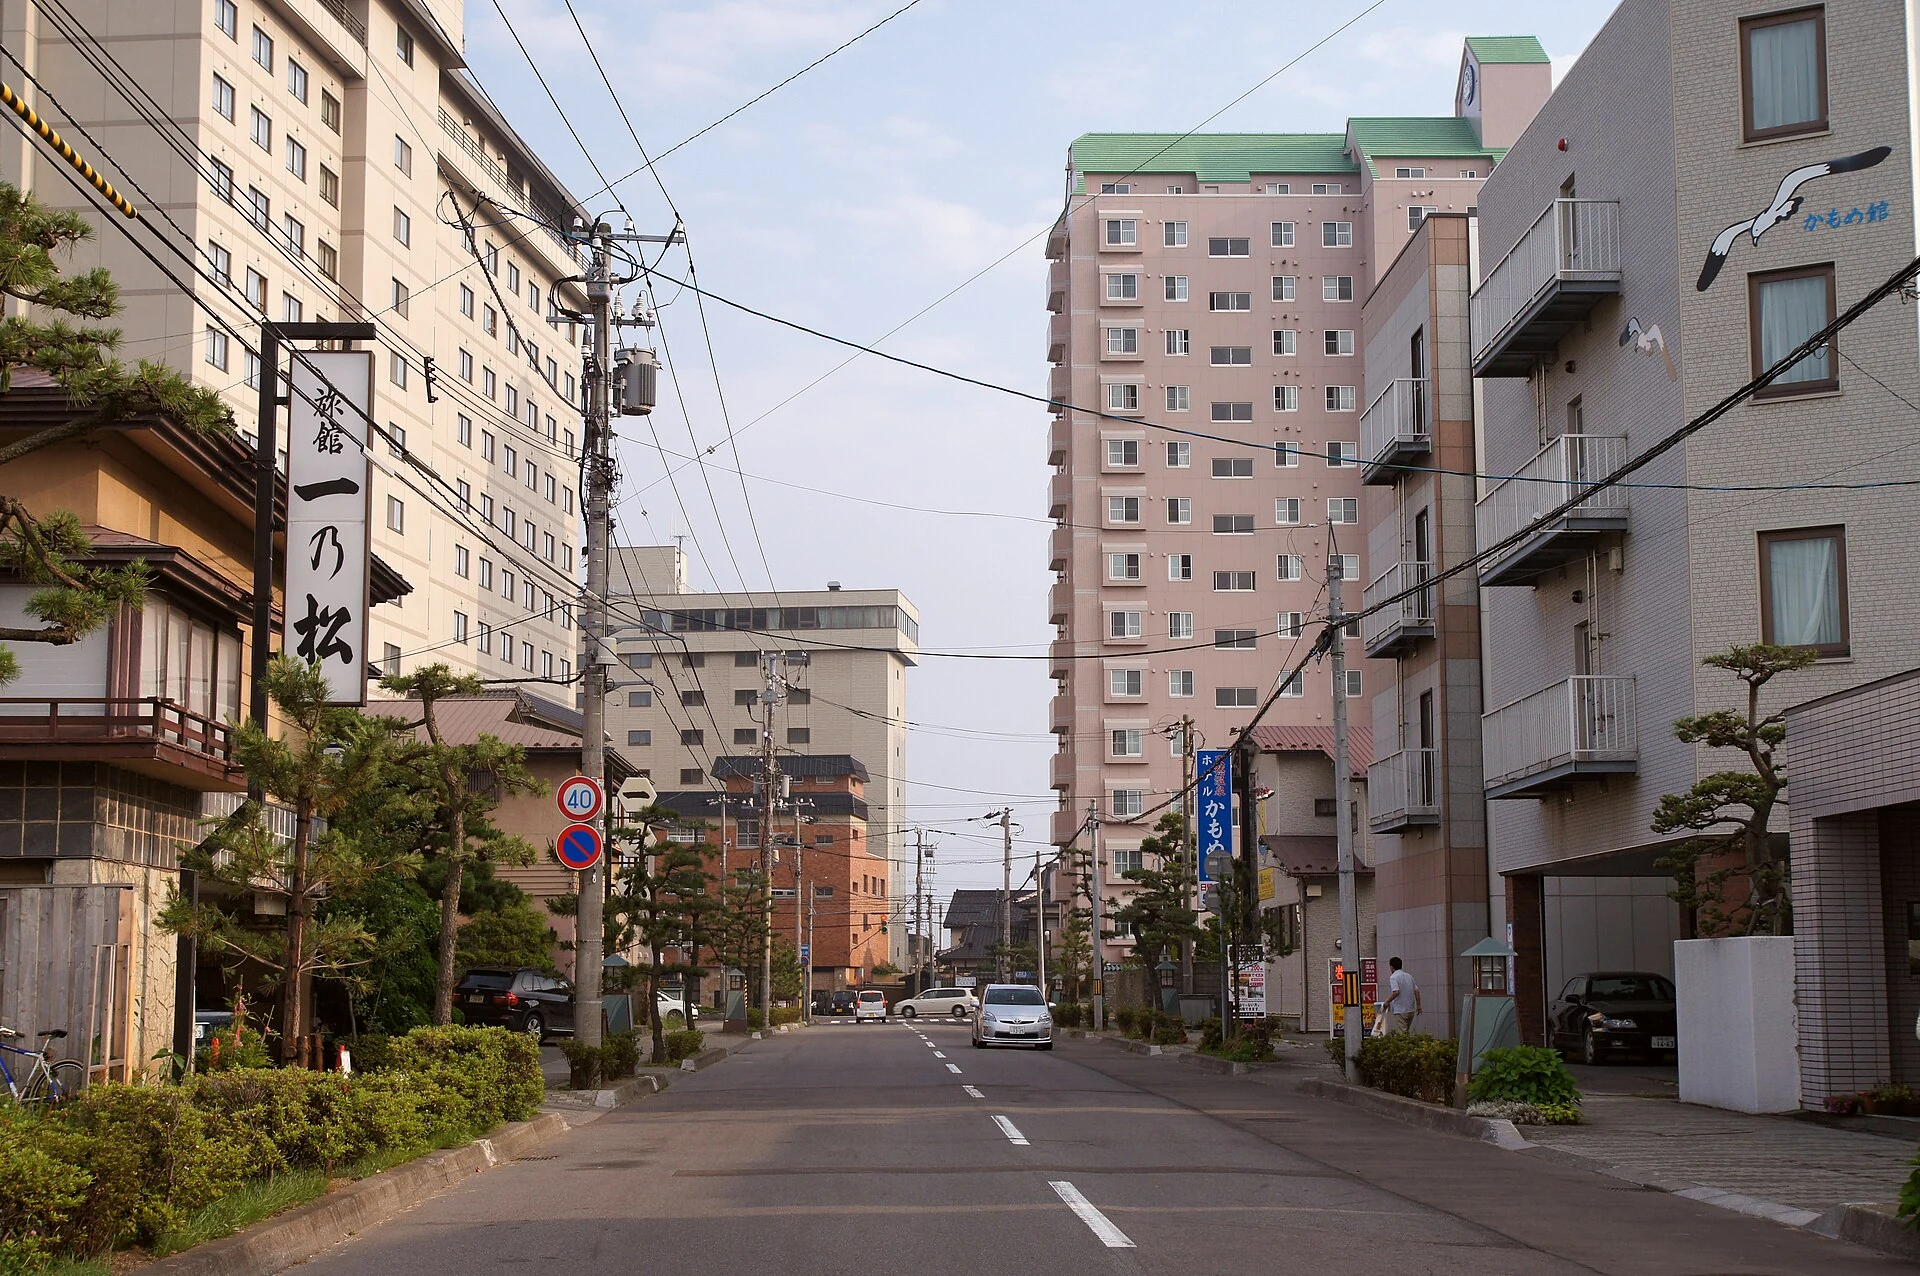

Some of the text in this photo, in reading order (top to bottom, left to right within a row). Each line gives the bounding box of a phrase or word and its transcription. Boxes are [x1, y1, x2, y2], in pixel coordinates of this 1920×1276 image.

[292, 386, 360, 666] 旅館 一乃松
[567, 789, 592, 809] 40
